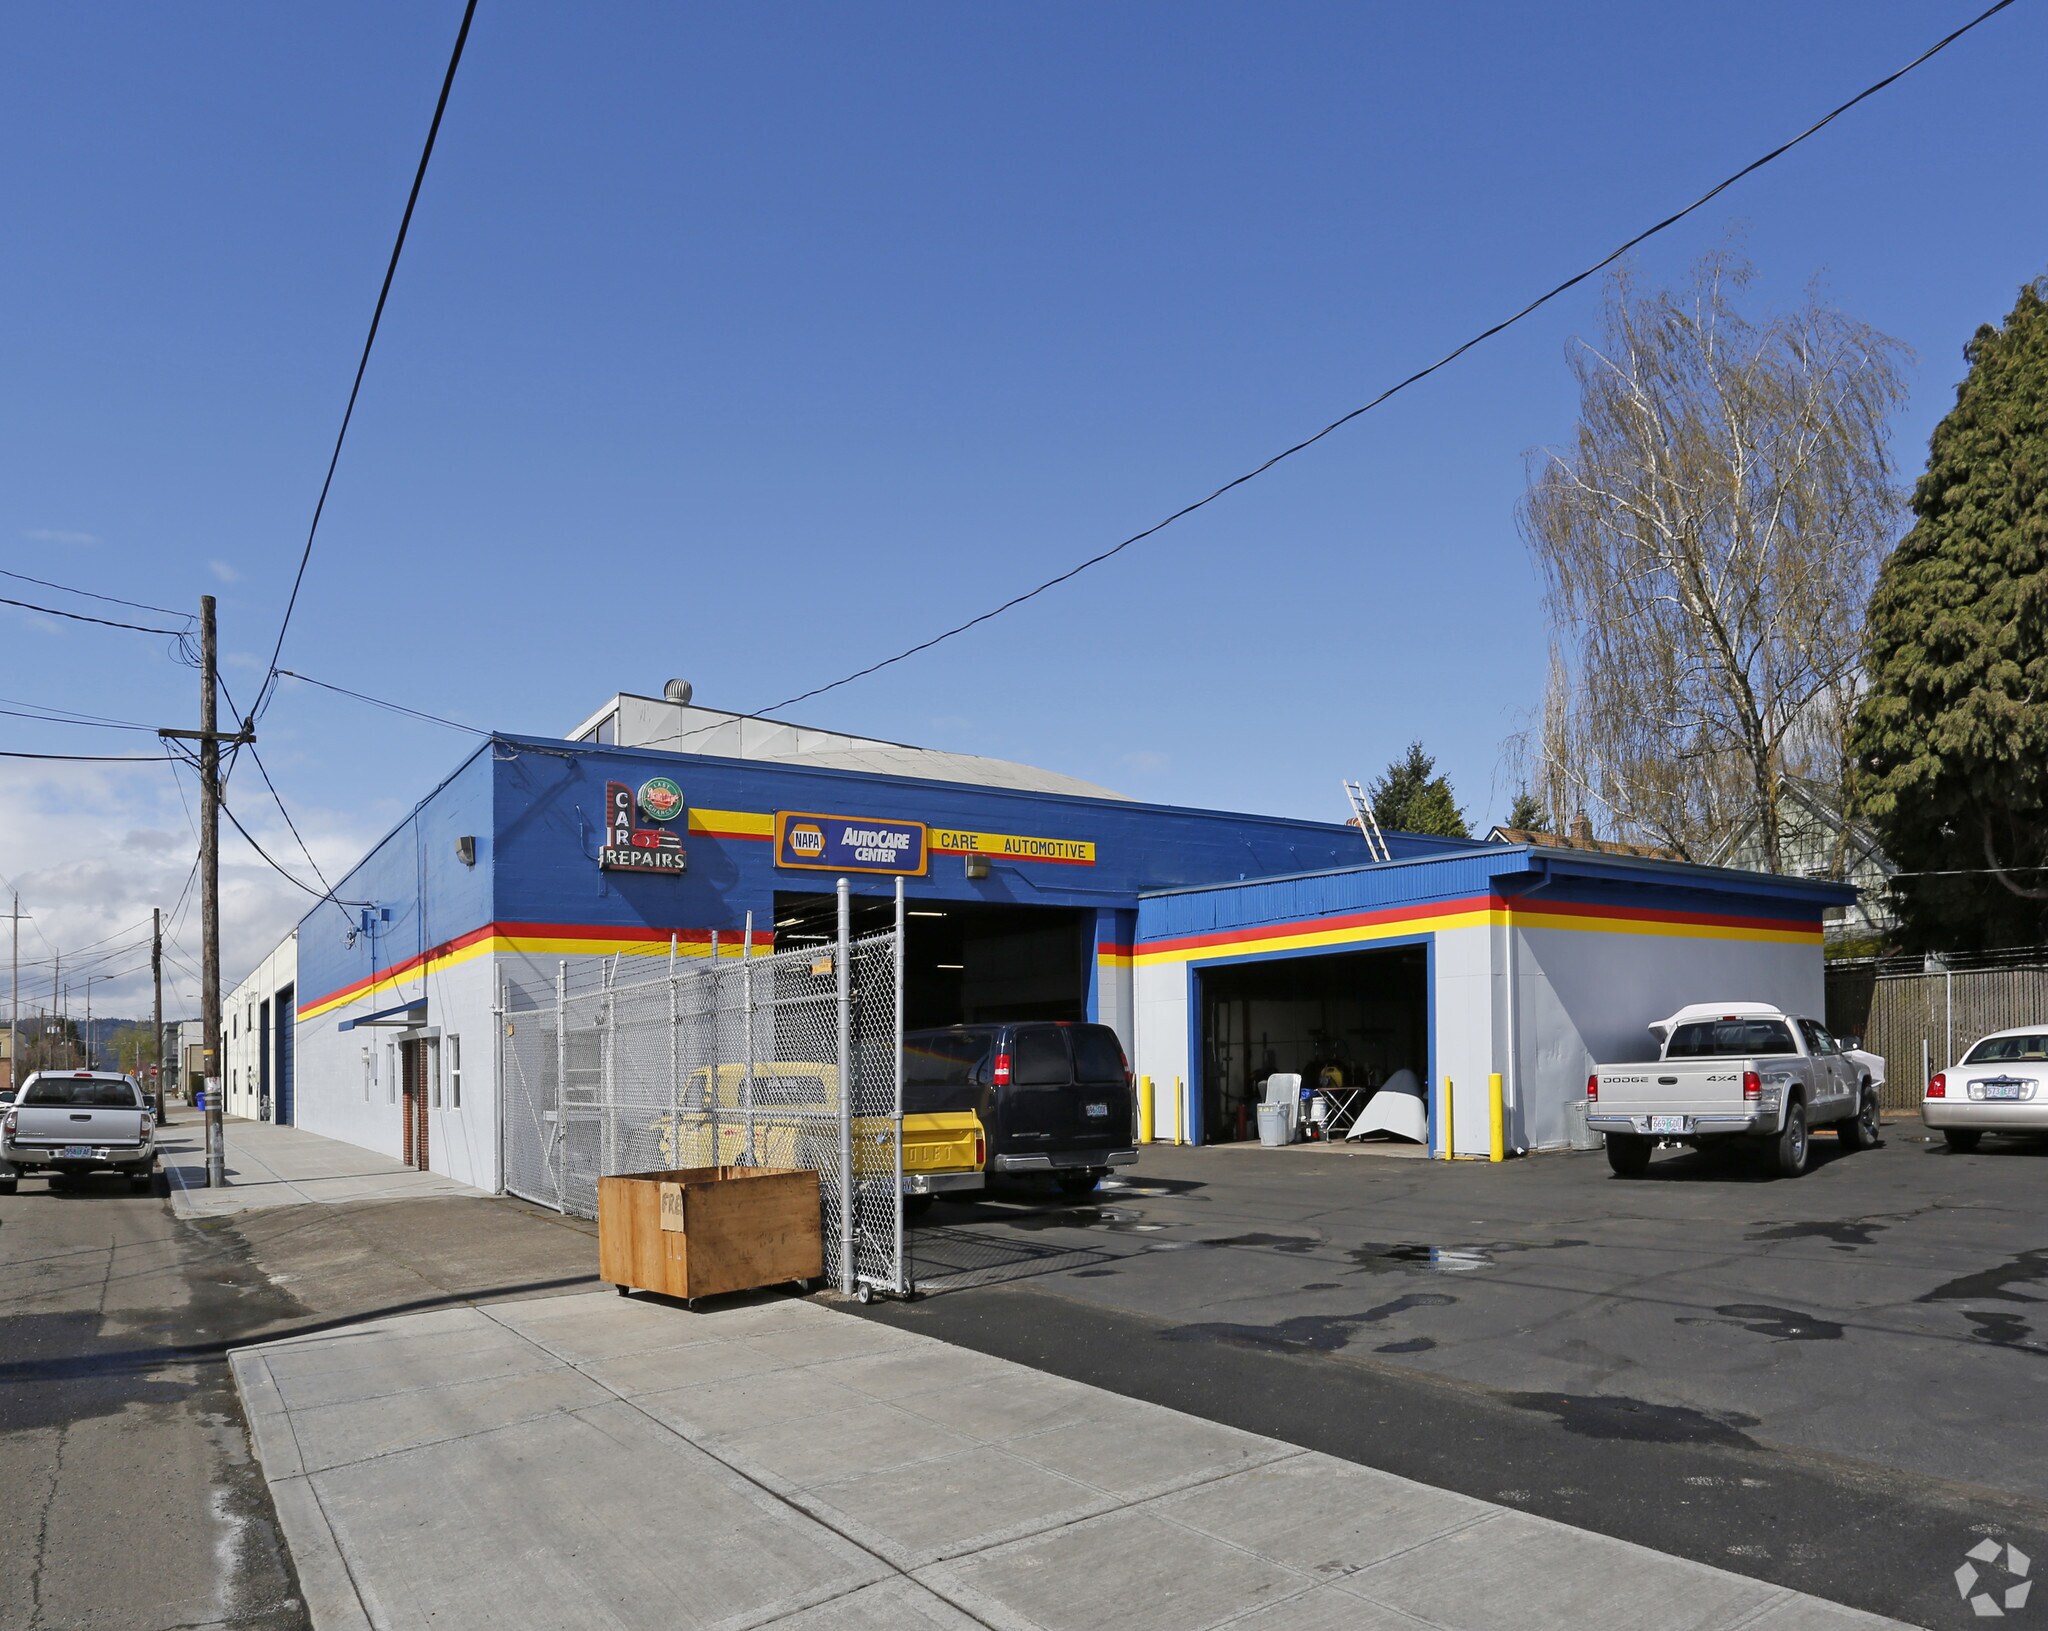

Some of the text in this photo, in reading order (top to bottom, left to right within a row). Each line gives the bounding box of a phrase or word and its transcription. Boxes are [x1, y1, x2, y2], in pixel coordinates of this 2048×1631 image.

[648, 804, 673, 815] CHANCE
[614, 792, 630, 846] CAR
[795, 833, 820, 850] NAPA
[941, 832, 1086, 859] CARE AUTOMOTIVE
[606, 849, 685, 868] REPAIRS
[854, 847, 896, 863] CENTER
[1987, 1087, 2000, 1095] 573
[1653, 1119, 1666, 1128] 669
[908, 1145, 953, 1163] OLET
